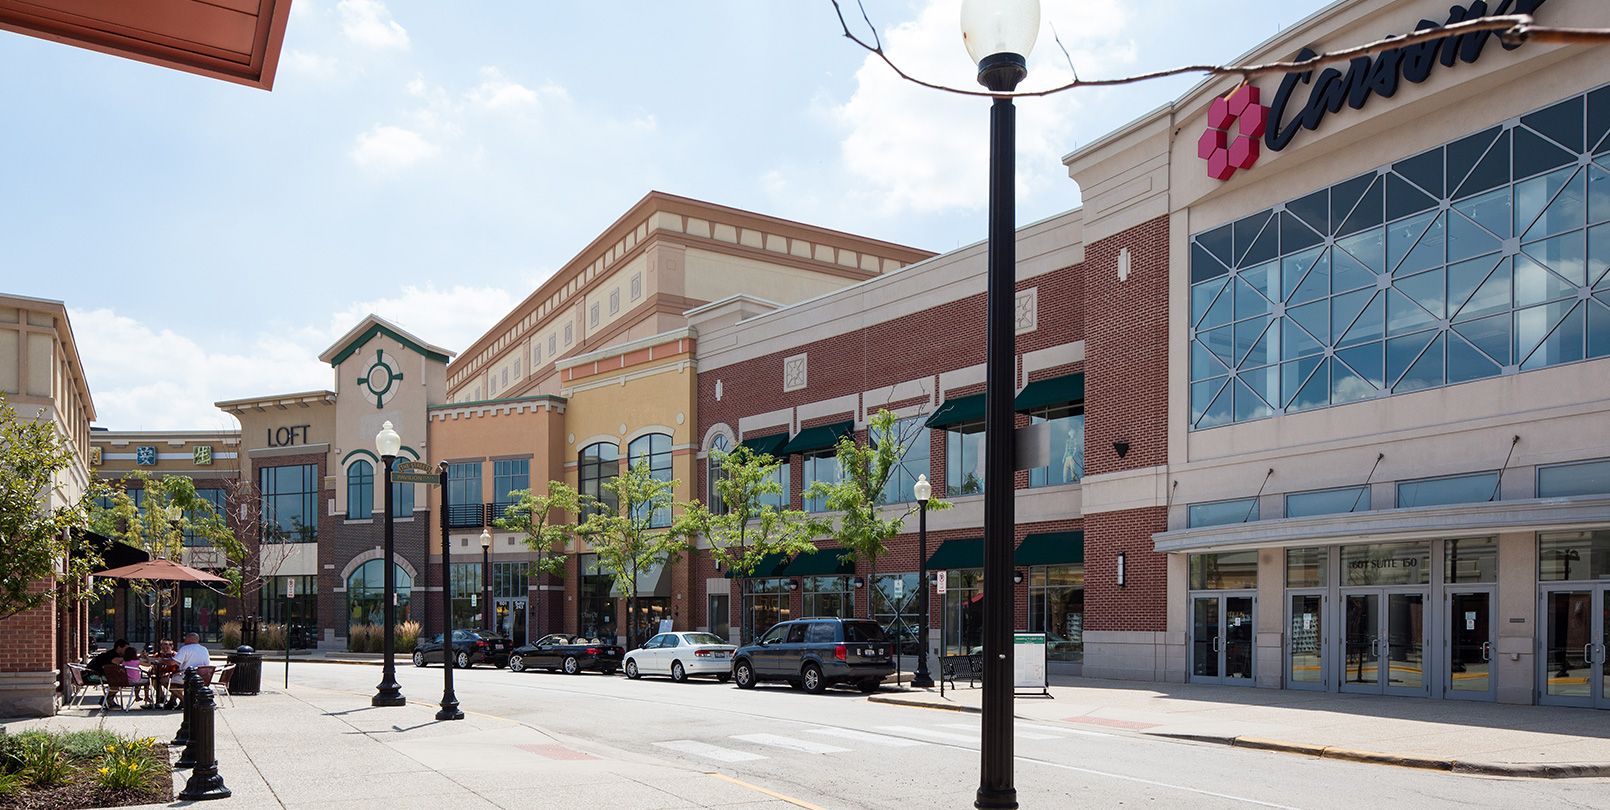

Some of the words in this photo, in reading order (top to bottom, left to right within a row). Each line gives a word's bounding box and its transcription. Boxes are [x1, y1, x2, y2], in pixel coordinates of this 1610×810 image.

[267, 424, 311, 447] LOFT
[1371, 558, 1397, 568] SUITE
[1401, 557, 1418, 568] 150
